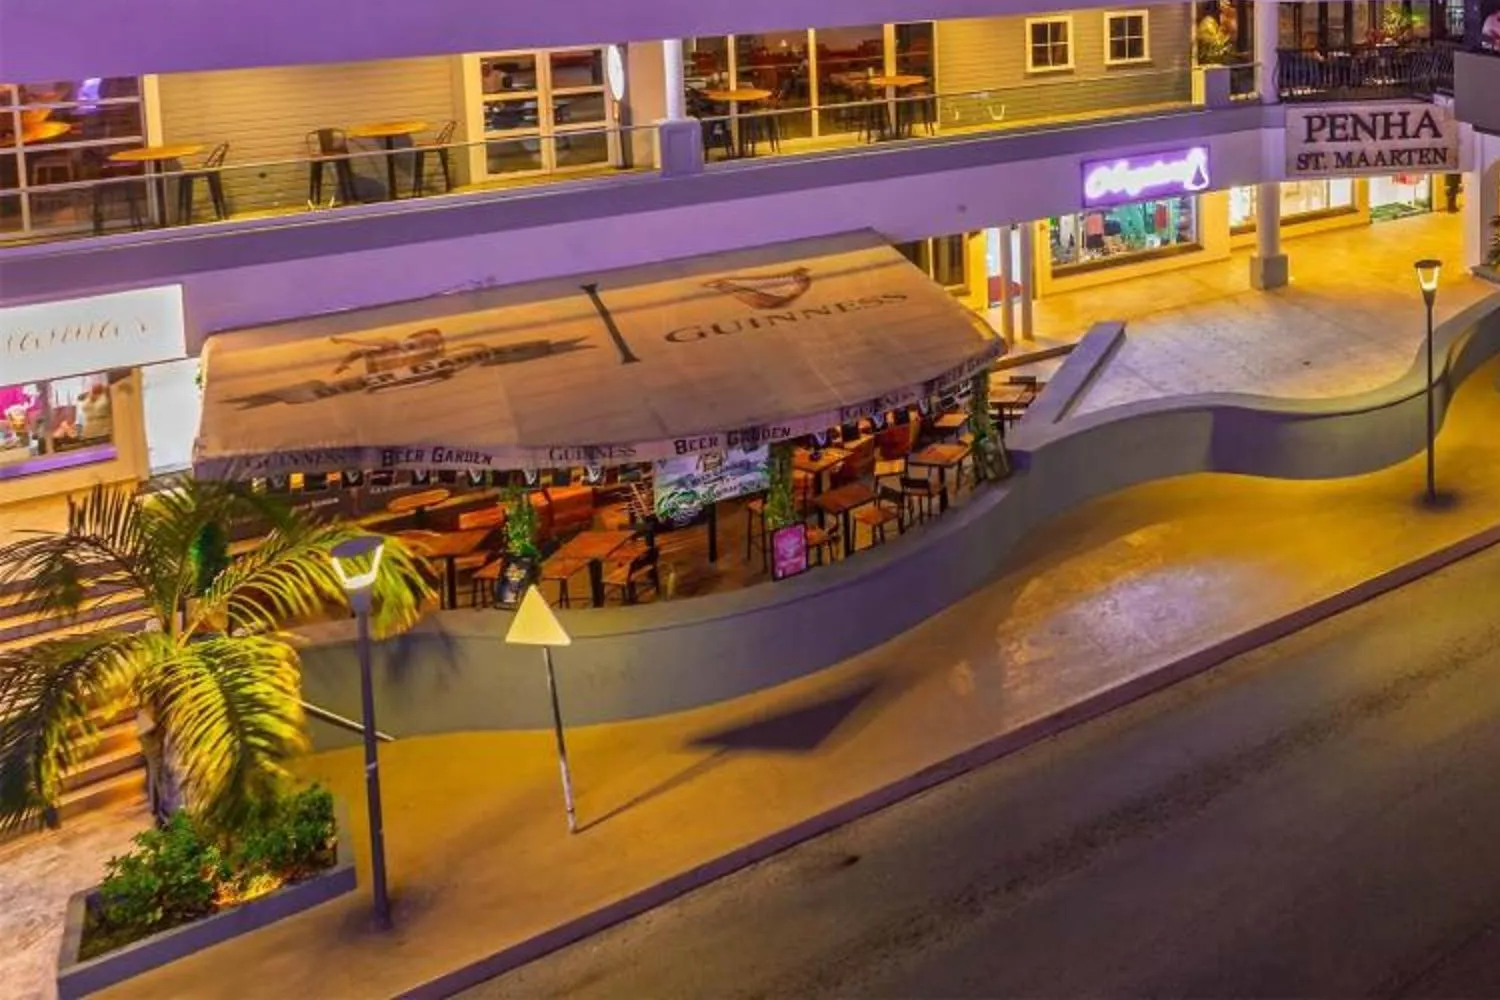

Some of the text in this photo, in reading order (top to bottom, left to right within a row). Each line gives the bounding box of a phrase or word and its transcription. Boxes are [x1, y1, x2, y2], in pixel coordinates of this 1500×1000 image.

[1303, 109, 1443, 143] PENHA
[1296, 147, 1448, 171] ST. MAARTEN
[664, 293, 909, 343] GUINNESS
[381, 450, 425, 468] BEER
[430, 446, 493, 466] GARDEN
[673, 436, 720, 456] BEER
